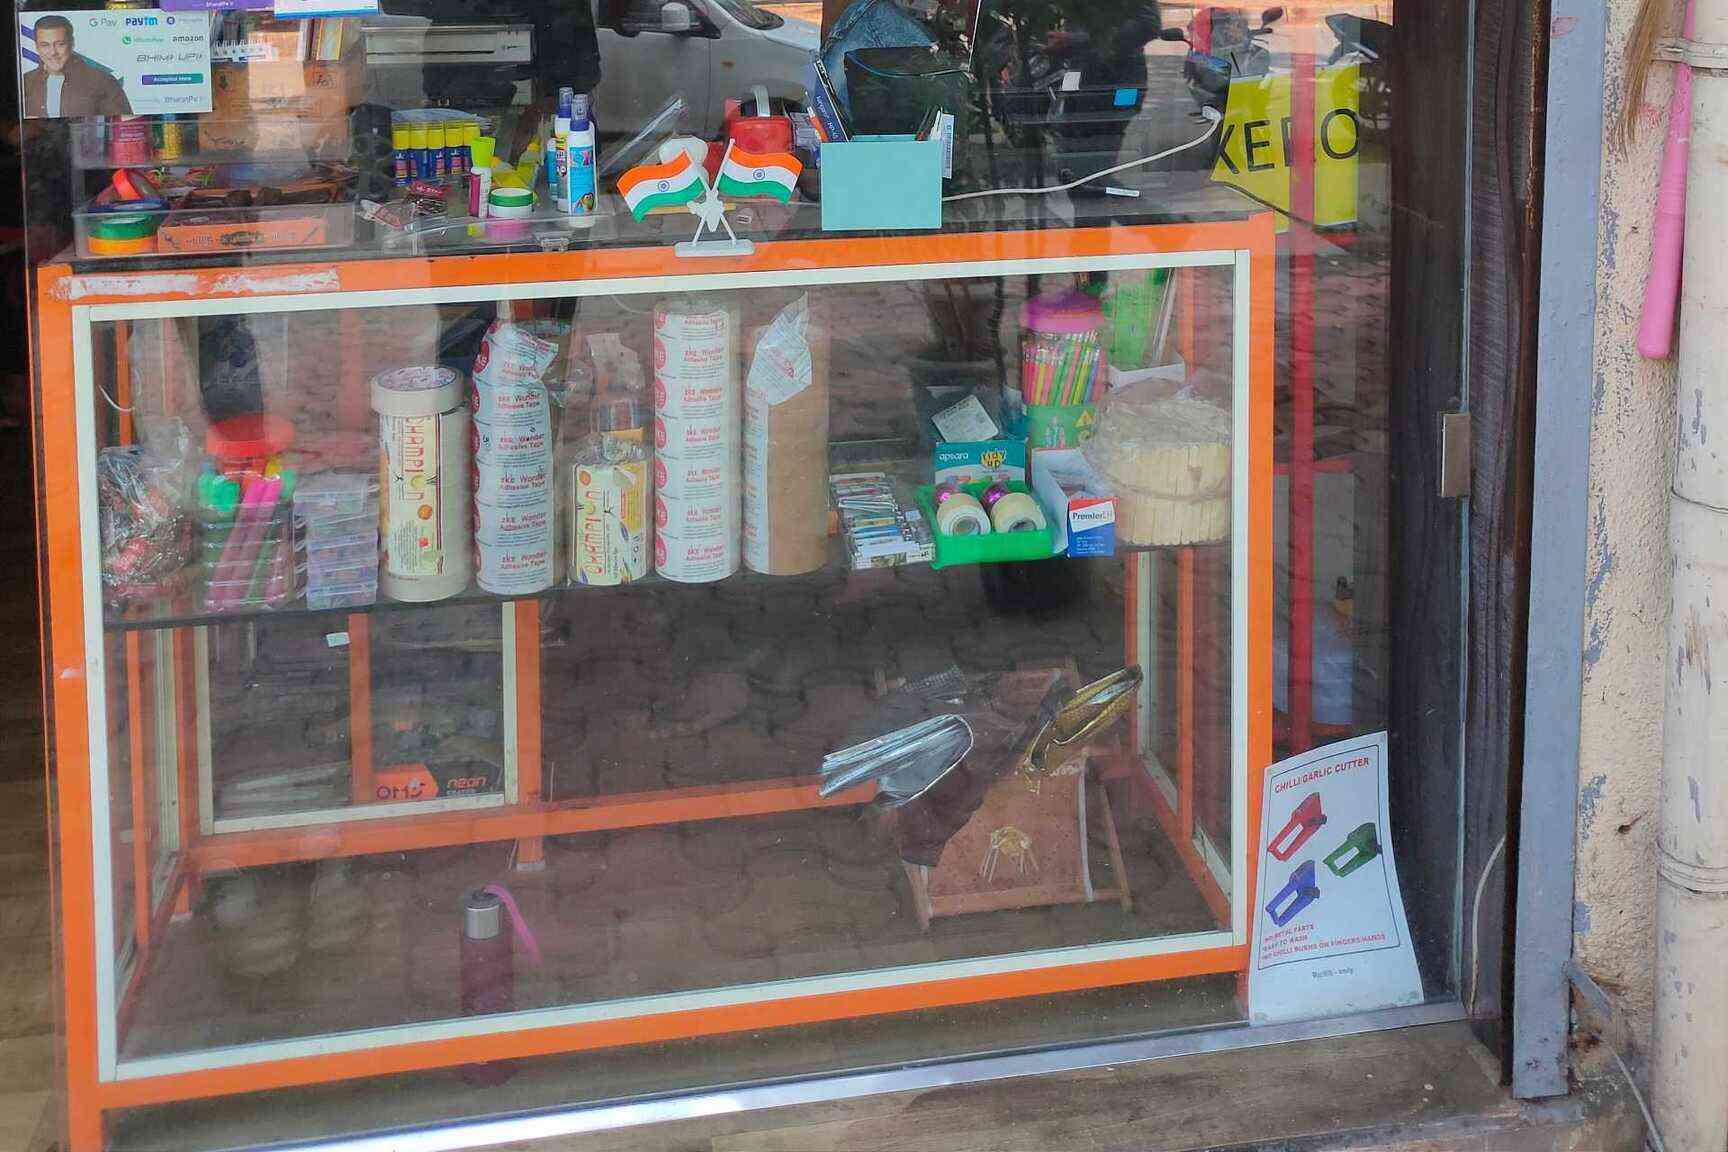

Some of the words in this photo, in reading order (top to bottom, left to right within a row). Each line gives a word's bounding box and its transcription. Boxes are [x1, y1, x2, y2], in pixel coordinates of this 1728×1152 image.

[939, 452, 969, 461] apsara
[1274, 776, 1300, 794] CHILLI
[1302, 766, 1333, 784] GARLIC
[1335, 756, 1370, 774] CUTTER
